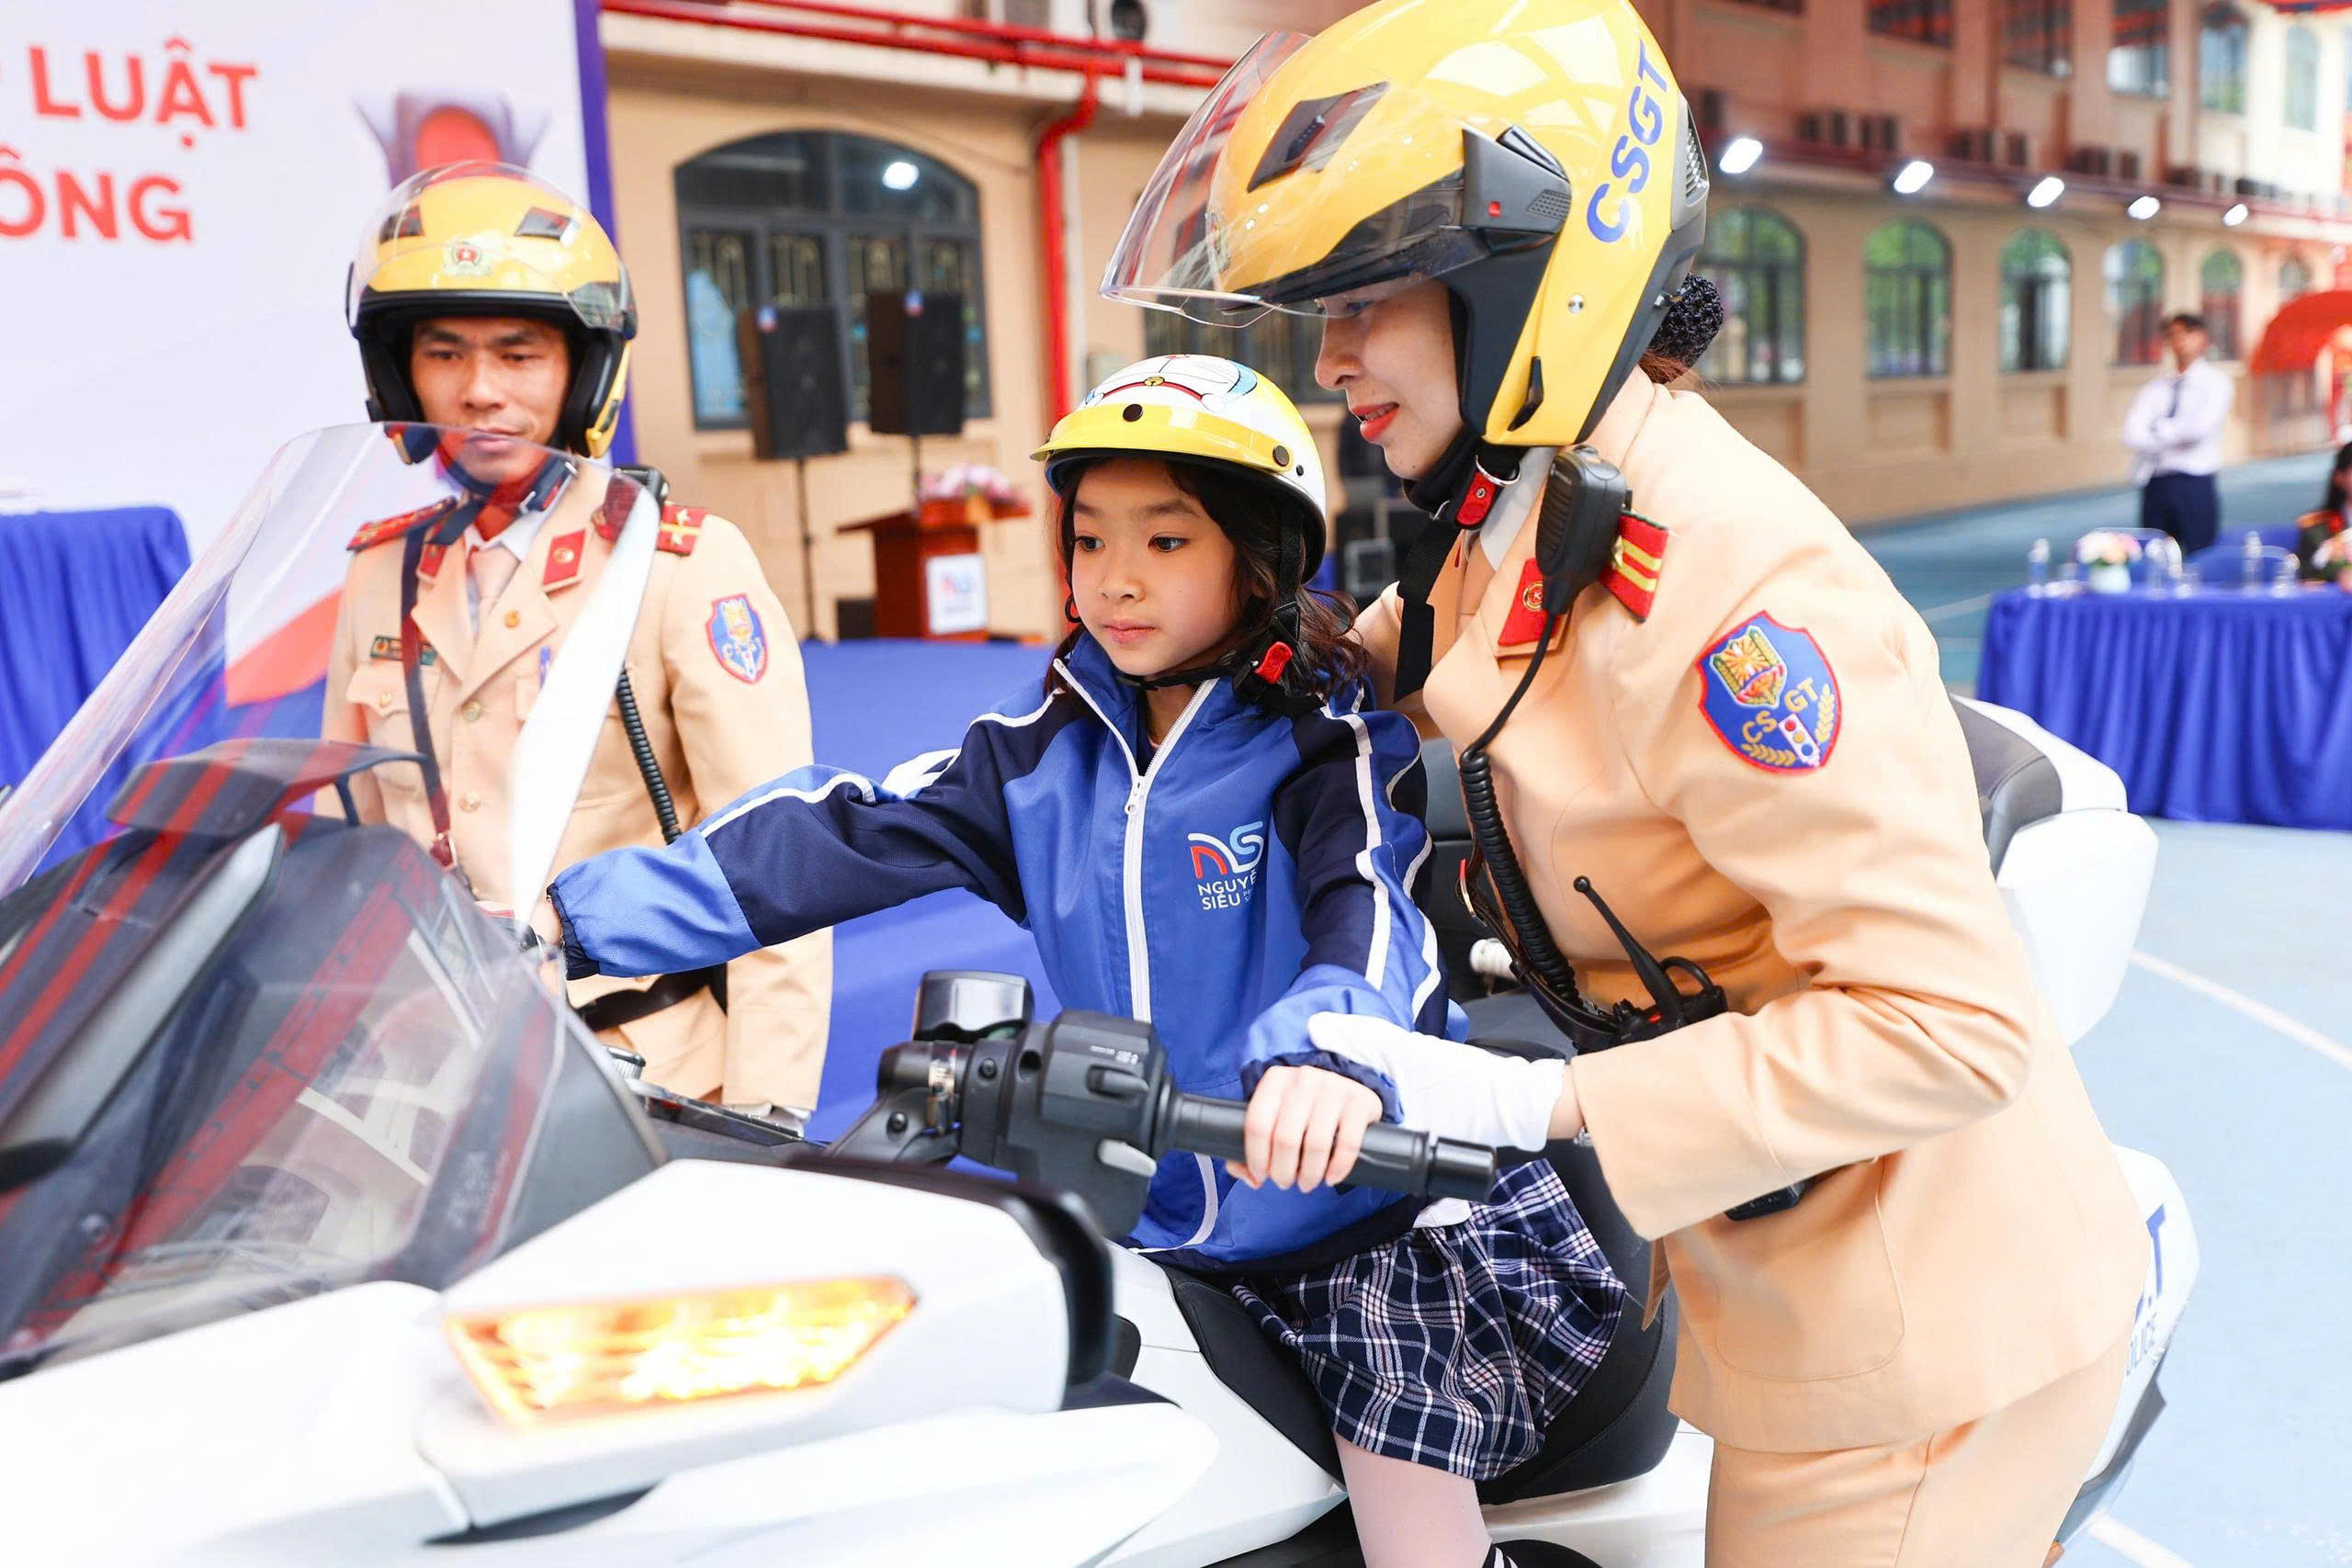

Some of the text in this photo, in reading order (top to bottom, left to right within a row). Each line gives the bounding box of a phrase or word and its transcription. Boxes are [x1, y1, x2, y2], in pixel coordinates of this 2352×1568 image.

[28, 37, 258, 148] LUẬT
[1587, 39, 1668, 243] CSGT
[1202, 892, 1241, 910] SIÊU
